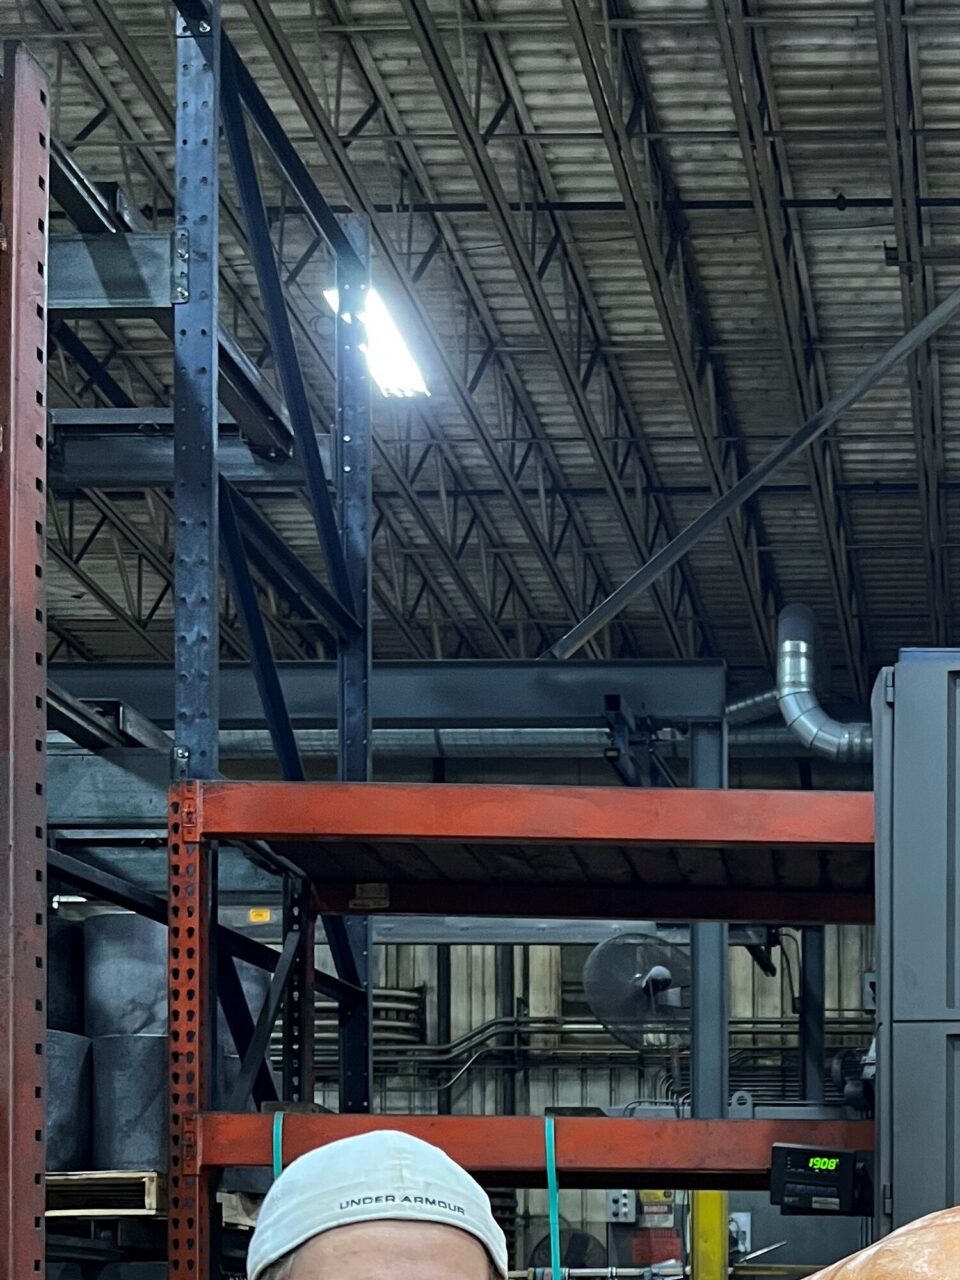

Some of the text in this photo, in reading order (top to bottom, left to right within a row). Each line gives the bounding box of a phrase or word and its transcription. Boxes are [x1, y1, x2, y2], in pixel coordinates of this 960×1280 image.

[808, 1156, 837, 1170] 1908
[340, 1195, 465, 1214] UNDER ARMOUR
